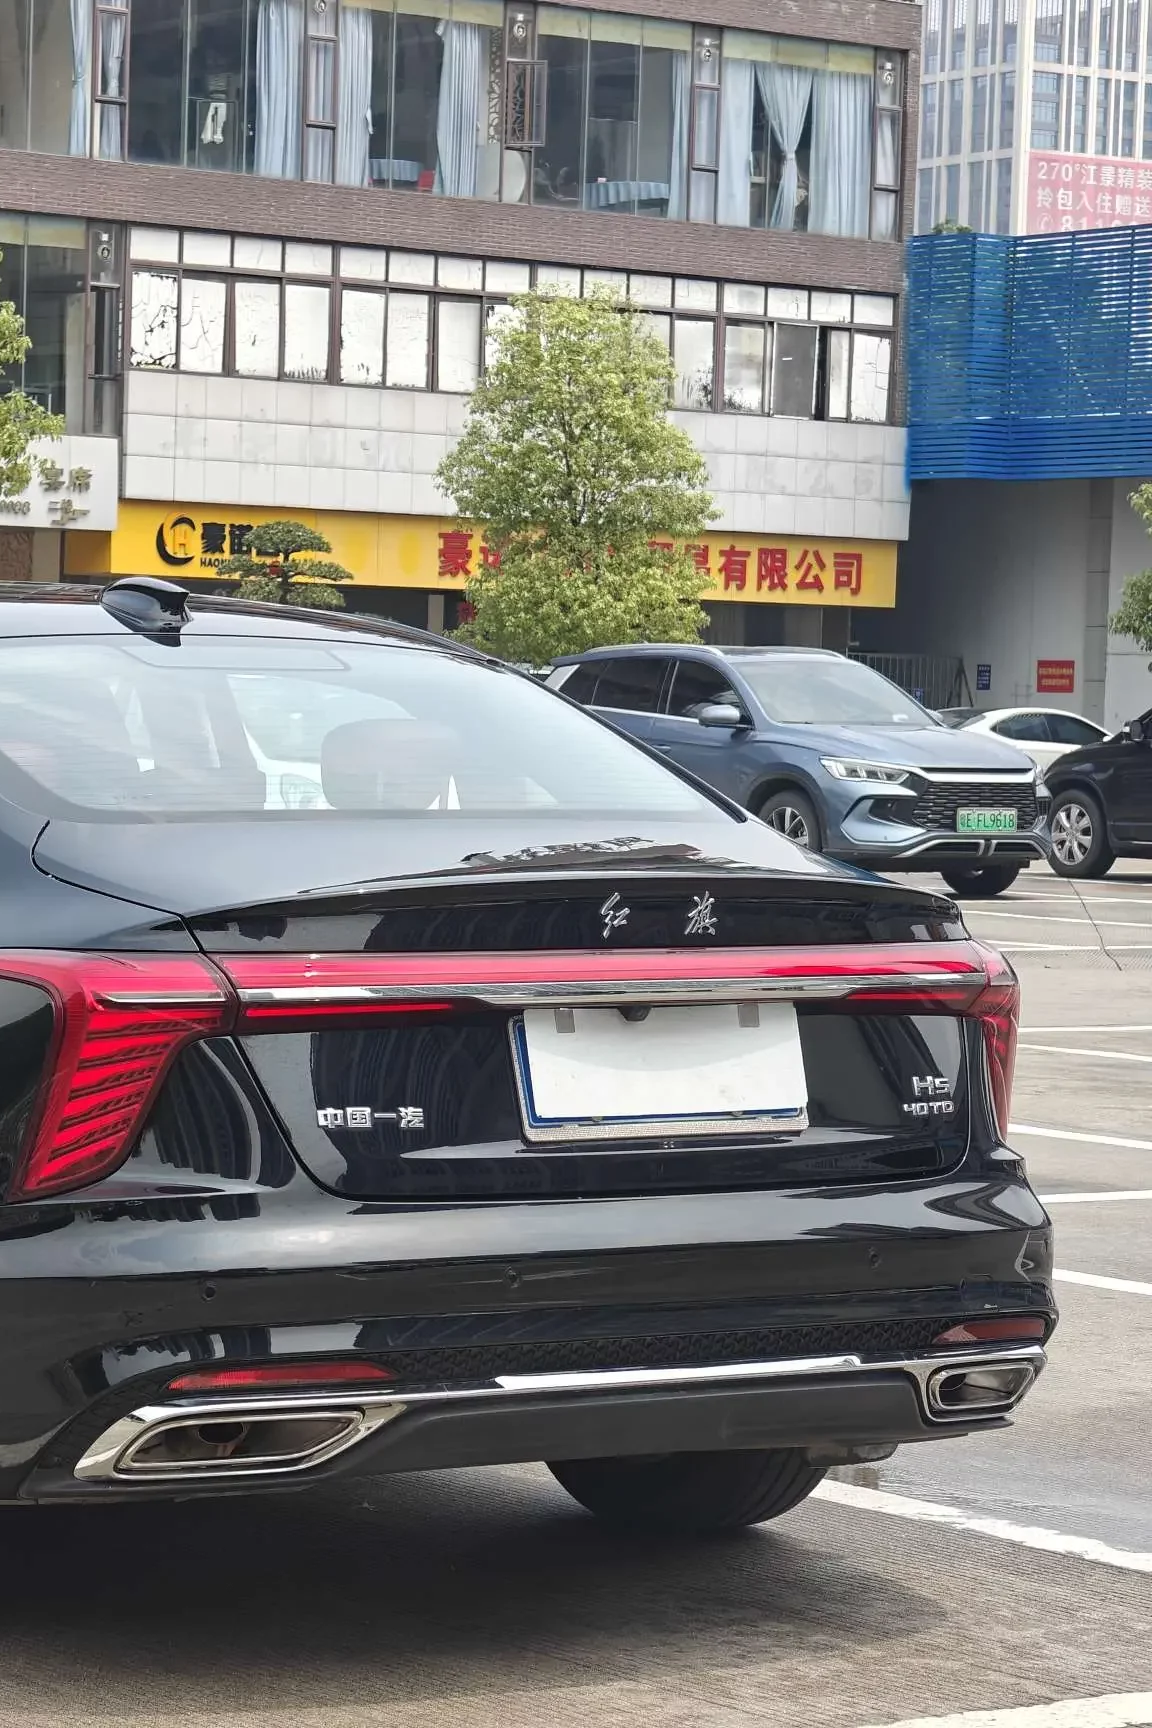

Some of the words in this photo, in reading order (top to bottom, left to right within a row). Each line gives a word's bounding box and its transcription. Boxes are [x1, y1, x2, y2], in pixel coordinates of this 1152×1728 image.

[902, 1100, 955, 1116] 40TD
[316, 1107, 425, 1129] 中国一汽
